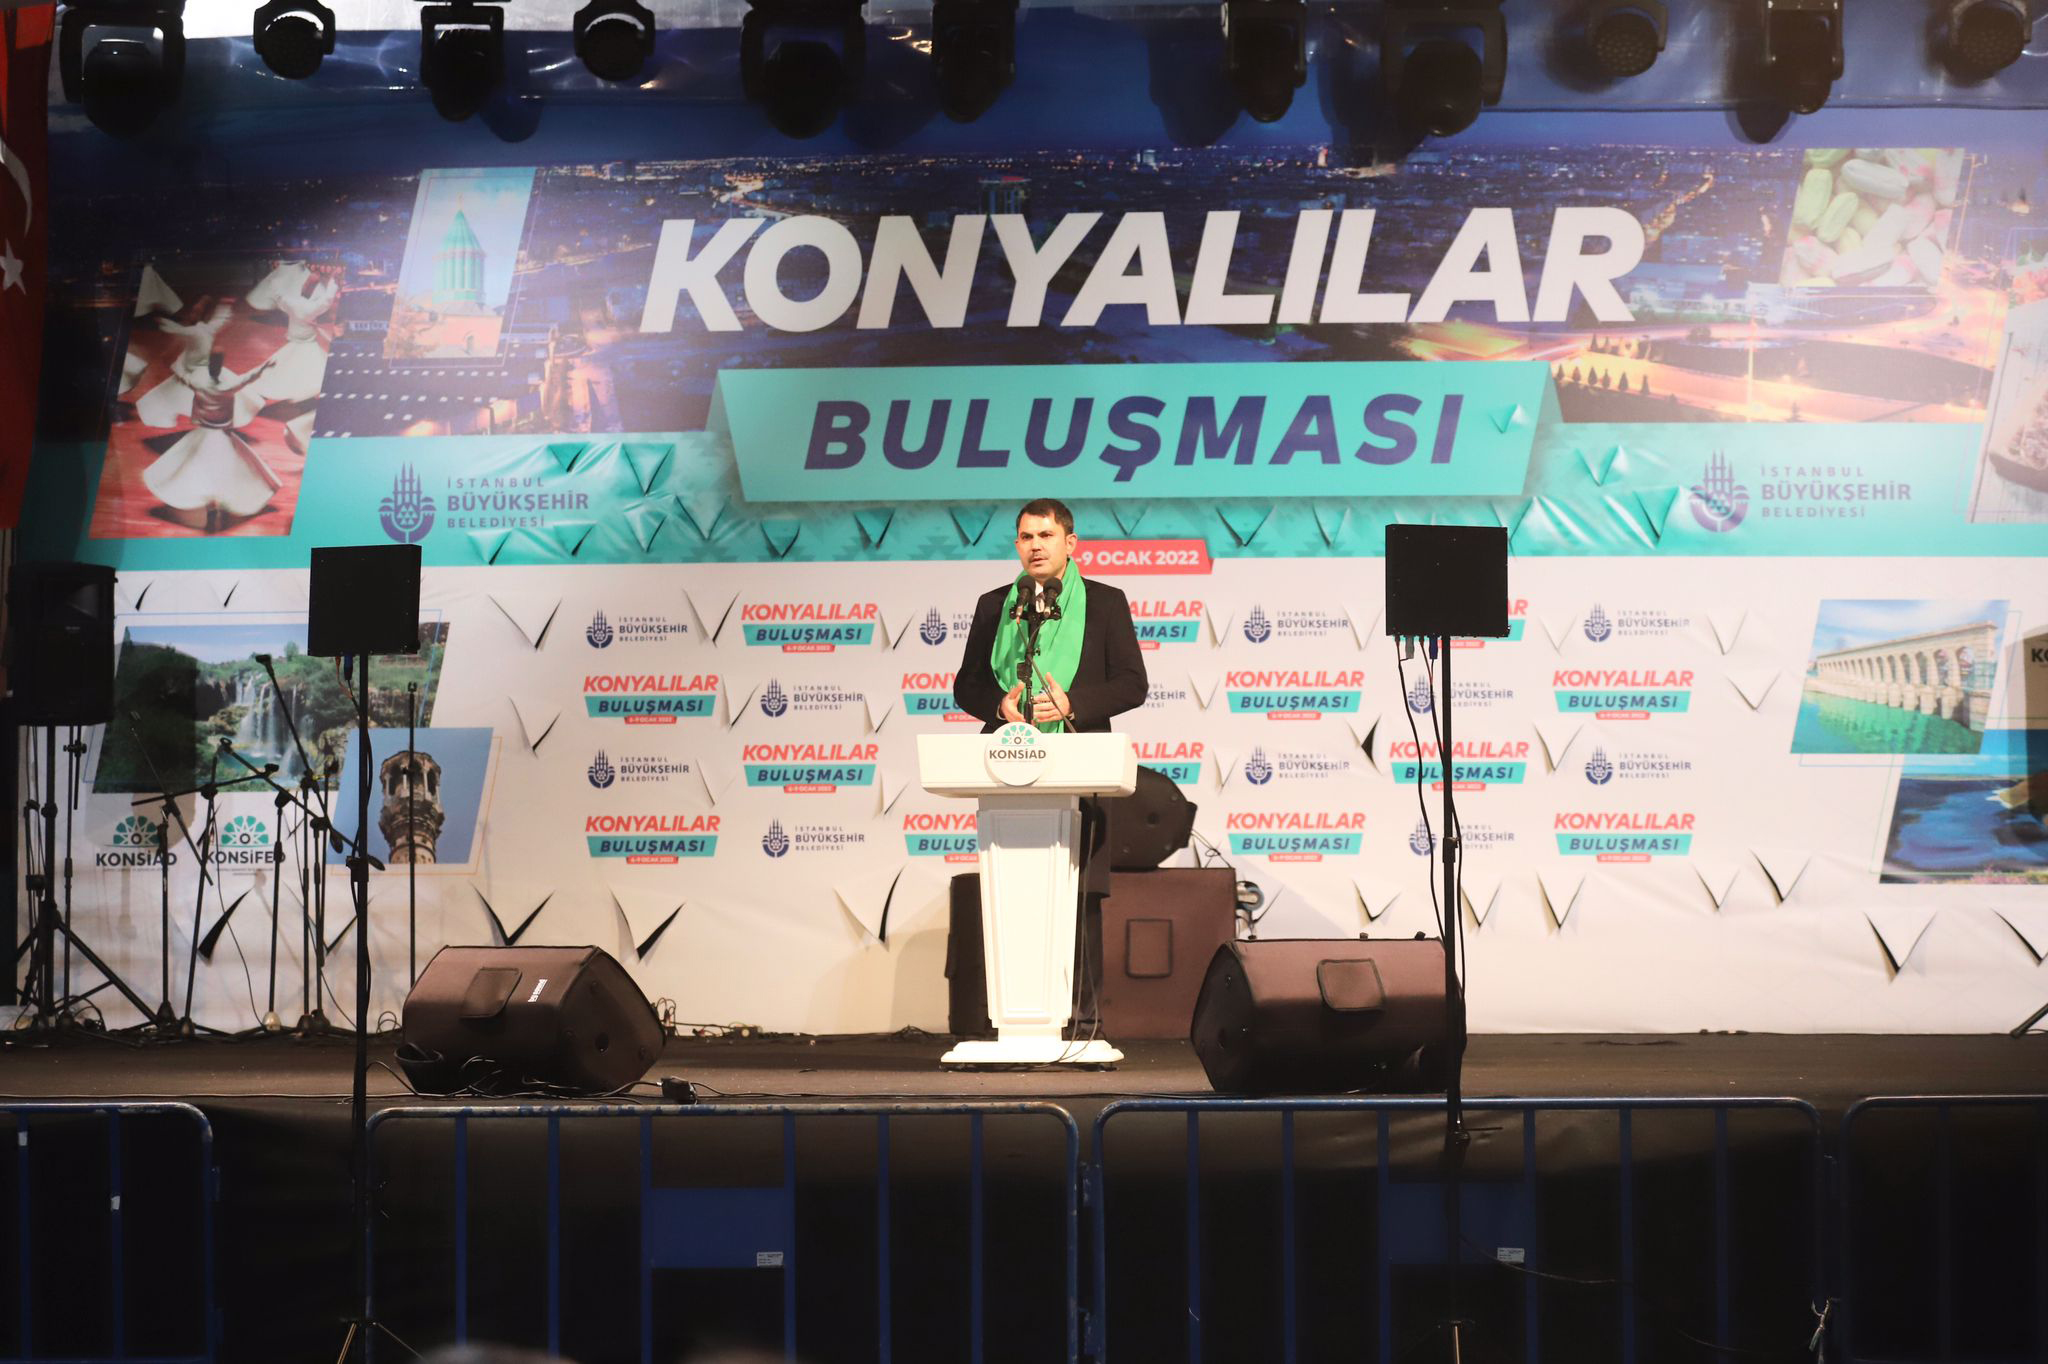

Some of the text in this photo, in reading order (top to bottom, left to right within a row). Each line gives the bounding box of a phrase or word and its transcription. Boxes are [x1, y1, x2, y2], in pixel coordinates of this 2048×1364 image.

[640, 206, 1645, 333] KONYALILAR
[804, 393, 1462, 482] BULUŞMASI
[1761, 464, 1864, 477] İSTANBUL
[447, 477, 545, 489] İSTANBUL
[1761, 481, 1912, 503] BÜYÜKŞEHİR
[447, 490, 589, 512] BÜYÜKŞEHİR
[1761, 505, 1866, 519] BELEDİYESİ
[447, 515, 545, 529] BELEDİYESİ
[1071, 550, 1200, 567] -9 OCAK 2022
[741, 603, 878, 621] KONYALILAR
[1130, 601, 1203, 617] ALILAR
[619, 623, 688, 635] BÜYÜKŞEHİR
[1277, 618, 1349, 629] BÜYÜKŞEHİR
[756, 628, 862, 645] BULUŞMASI
[584, 674, 719, 692] KONYALILAR
[1226, 671, 1364, 688] KONYALILAR
[1552, 670, 1694, 687] KONYALILAR
[794, 692, 863, 704] BÜYÜKŞEHİR
[1147, 690, 1186, 700] KŞEHİR
[1451, 689, 1513, 700] ÜYÜKŞEHİR
[598, 699, 704, 715] BULUŞMASI
[1240, 696, 1349, 712] BULUŞMASI
[1568, 695, 1677, 711] BULUŞMASI
[742, 744, 879, 761] KONYALILAR
[989, 748, 1047, 759] KONSİAD
[1389, 742, 1529, 758] KONALILAR
[620, 763, 690, 774] BÜYÜKŞEHİR
[1279, 759, 1349, 770] BÜYÜKŞEHİR
[1619, 760, 1691, 771] BÜYÜKŞEHİR
[758, 769, 863, 786] BULUŞMASI
[1405, 766, 1513, 780] BULŞMASI
[585, 815, 721, 832] KONYALILAR
[903, 814, 977, 830] KONYA
[1226, 812, 1366, 829] KONYALILAR
[1553, 813, 1695, 830] KONYALILAR
[795, 832, 865, 844] BÜYÜKŞEHİR
[918, 838, 976, 853] BULUŞ
[1241, 838, 1350, 854] BULUŞMASI
[1569, 838, 1680, 854] BULUŞMASI
[600, 840, 705, 857] BULUŞMASI
